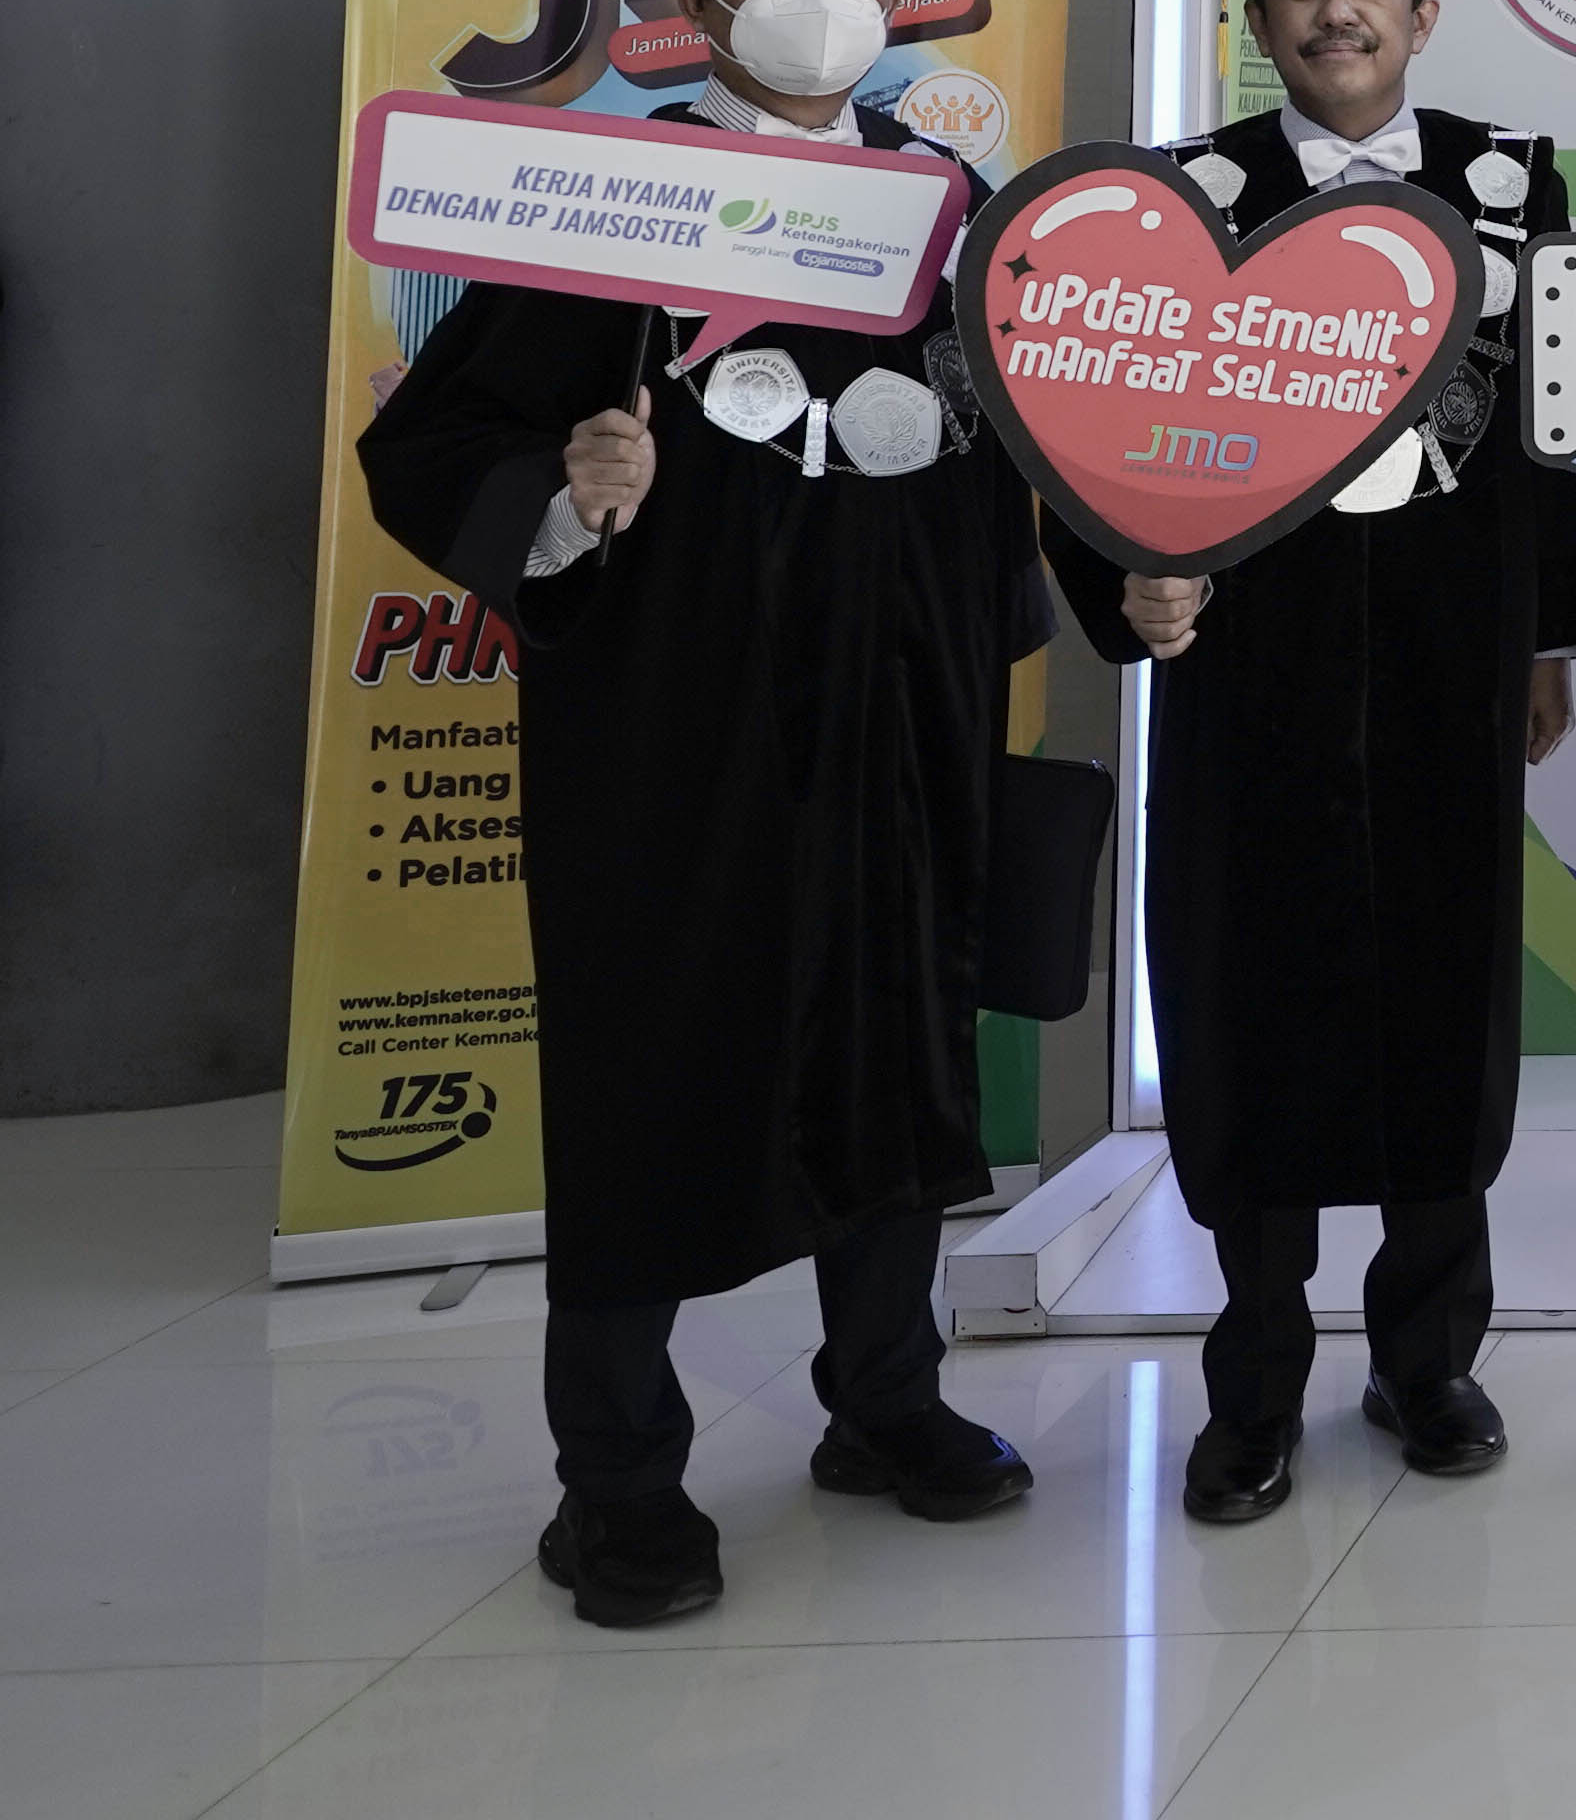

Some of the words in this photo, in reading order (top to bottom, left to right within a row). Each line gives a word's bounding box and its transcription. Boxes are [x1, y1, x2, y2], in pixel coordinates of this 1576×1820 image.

[511, 165, 595, 199] KERJA
[601, 177, 716, 214] NYAMAN
[385, 186, 502, 224] DENGAN
[506, 201, 548, 229] BP
[549, 207, 709, 249] JAMSOSTEK
[784, 209, 840, 231] BPJS
[781, 227, 911, 257] Ketenagakerjaan
[731, 243, 766, 257] panggil
[801, 251, 877, 274] bpjamsostek
[1124, 424, 1259, 472] JMO
[371, 721, 520, 751] Manfaat
[404, 771, 511, 802] Uang
[338, 1039, 376, 1057] Call
[382, 1034, 450, 1053] Center
[379, 1071, 473, 1120] 175
[335, 1120, 460, 1141] TanyaBPJAMSOSTEK
